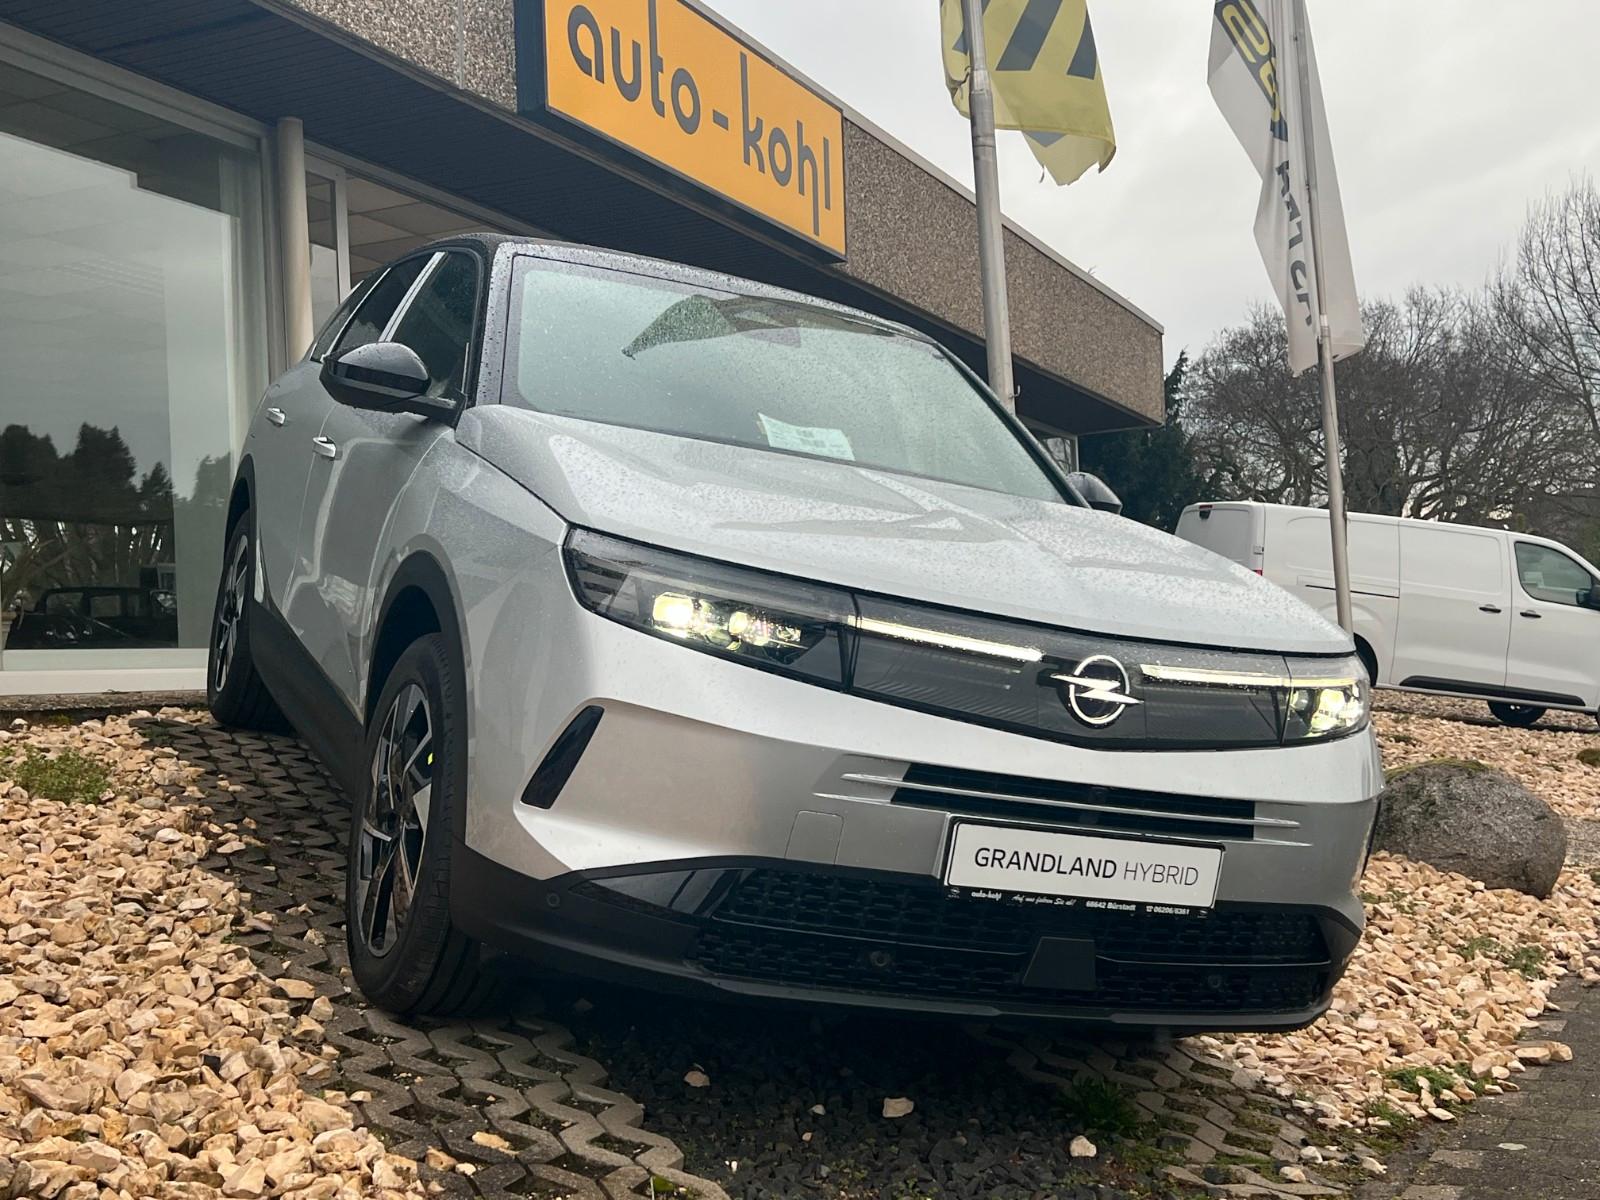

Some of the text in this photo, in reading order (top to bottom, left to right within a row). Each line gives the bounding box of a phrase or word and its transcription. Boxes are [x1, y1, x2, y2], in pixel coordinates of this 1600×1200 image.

[567, 0, 831, 236] auto-kohl
[974, 847, 1199, 886] GRANDLAND HYBRID
